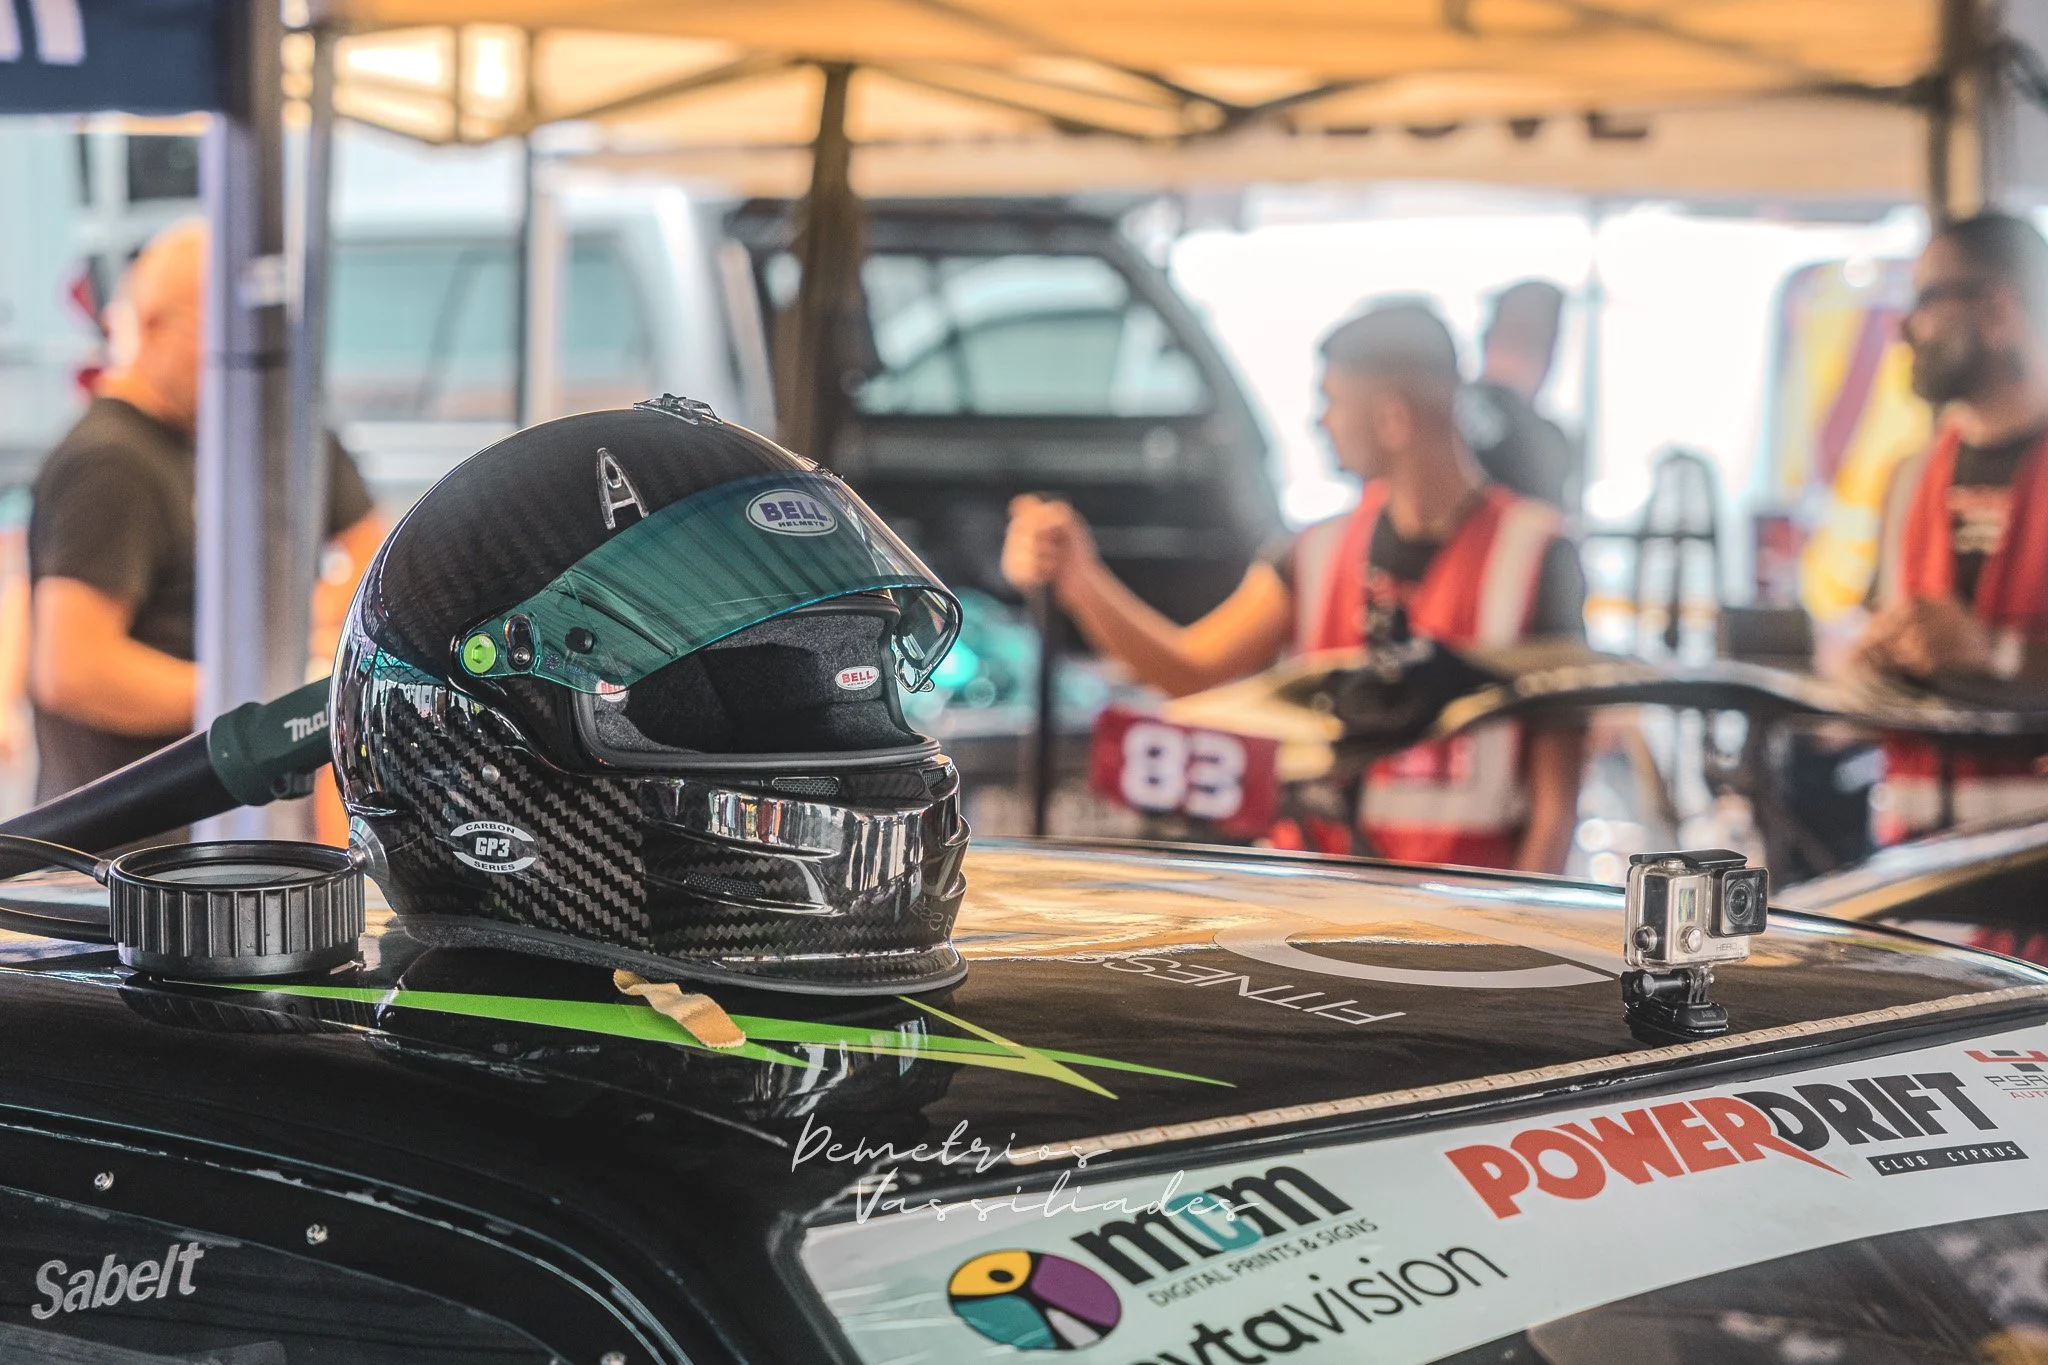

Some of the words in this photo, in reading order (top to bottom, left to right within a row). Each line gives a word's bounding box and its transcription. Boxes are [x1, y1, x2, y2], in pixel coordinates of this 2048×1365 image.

[759, 501, 828, 522] BELL
[777, 520, 825, 528] HELMETS
[841, 670, 873, 683] BELL
[1120, 722, 1248, 819] 83
[465, 823, 515, 834] CARBON
[475, 837, 510, 857] GP3
[473, 861, 516, 871] SERIES
[1878, 1155, 1929, 1171] CLUB
[1946, 1145, 2018, 1162] CYPRUS
[1147, 1268, 1233, 1308] DIGITAL
[1226, 1243, 1301, 1276] PRINTS
[1299, 1236, 1319, 1251] &
[1315, 1217, 1379, 1246] SIGNS
[31, 1241, 205, 1320] Sabelt
